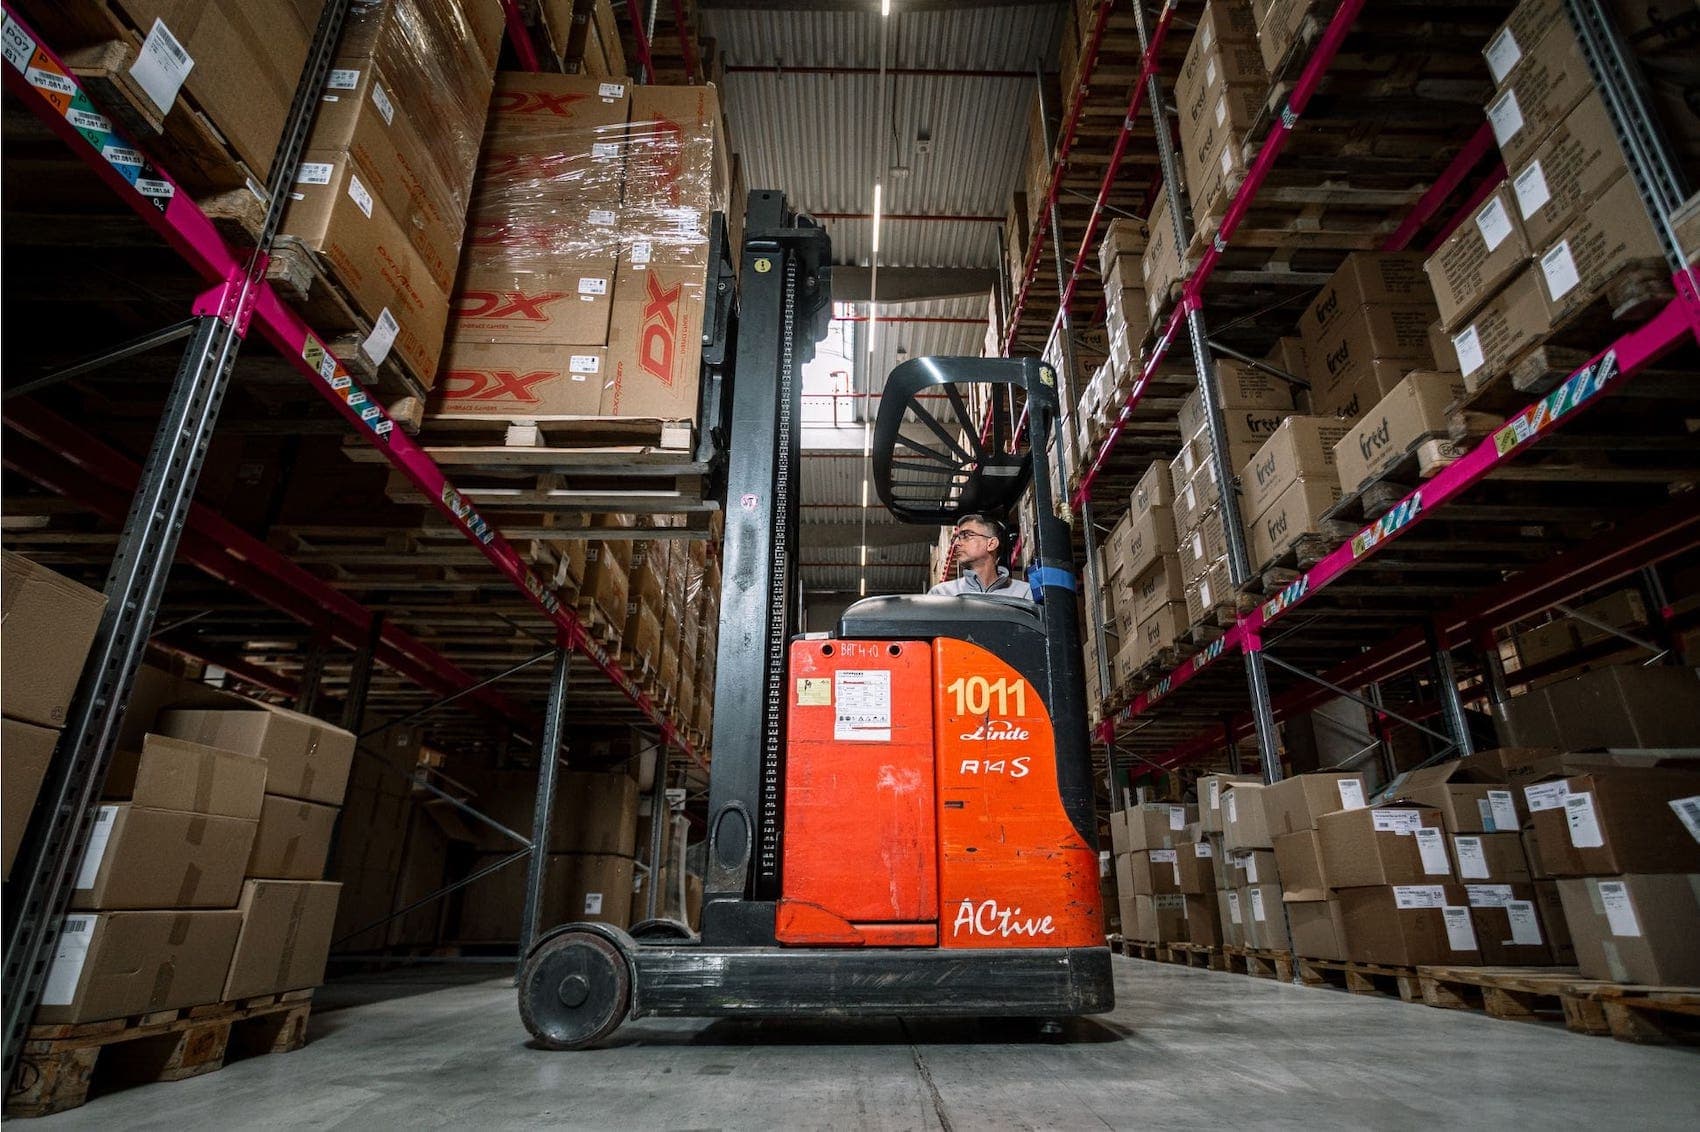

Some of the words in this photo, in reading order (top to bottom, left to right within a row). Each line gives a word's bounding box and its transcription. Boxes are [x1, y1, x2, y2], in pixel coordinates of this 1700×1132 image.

[6, 27, 30, 52] P07
[641, 268, 682, 386] DX
[437, 368, 561, 402] DX
[841, 643, 857, 657] BAT
[947, 675, 1026, 717] 1011
[959, 719, 1030, 742] Linde
[953, 897, 1056, 939] ACtive
